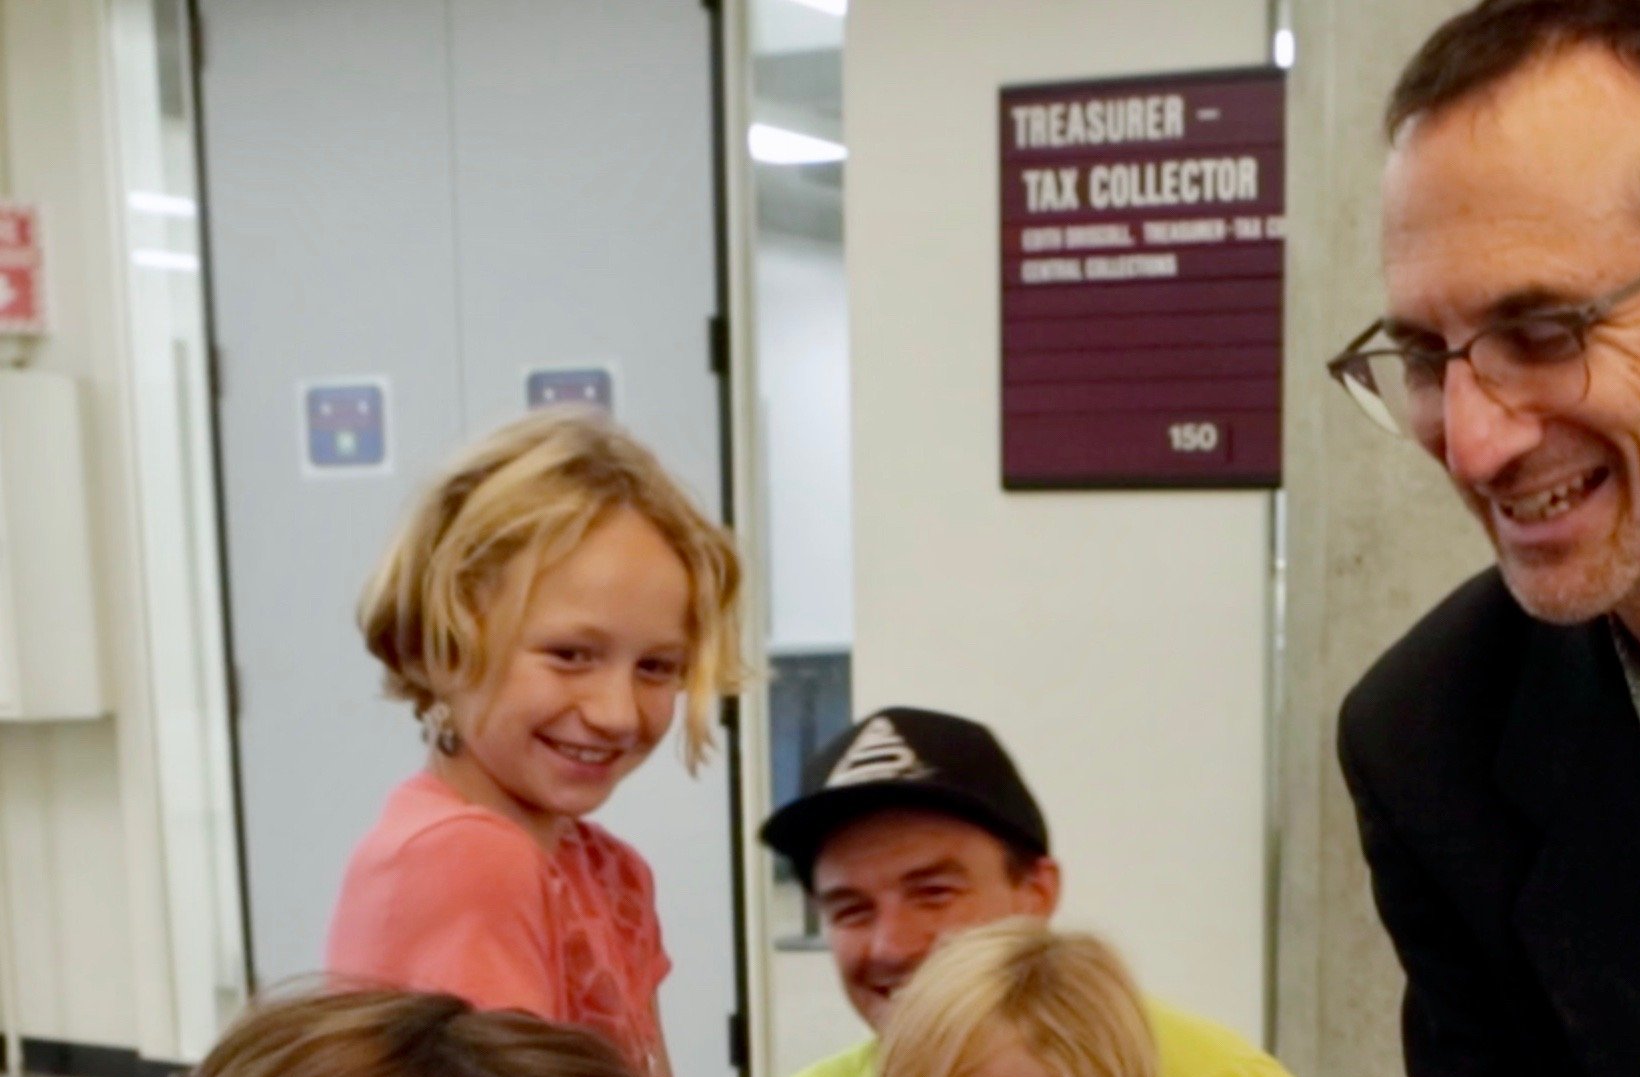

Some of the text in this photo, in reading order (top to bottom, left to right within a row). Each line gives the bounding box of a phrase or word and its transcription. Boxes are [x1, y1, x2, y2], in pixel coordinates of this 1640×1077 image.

[1011, 95, 1184, 149] TREASURER
[1022, 156, 1258, 213] TAX COLLECTOR
[1168, 423, 1218, 451] 150
